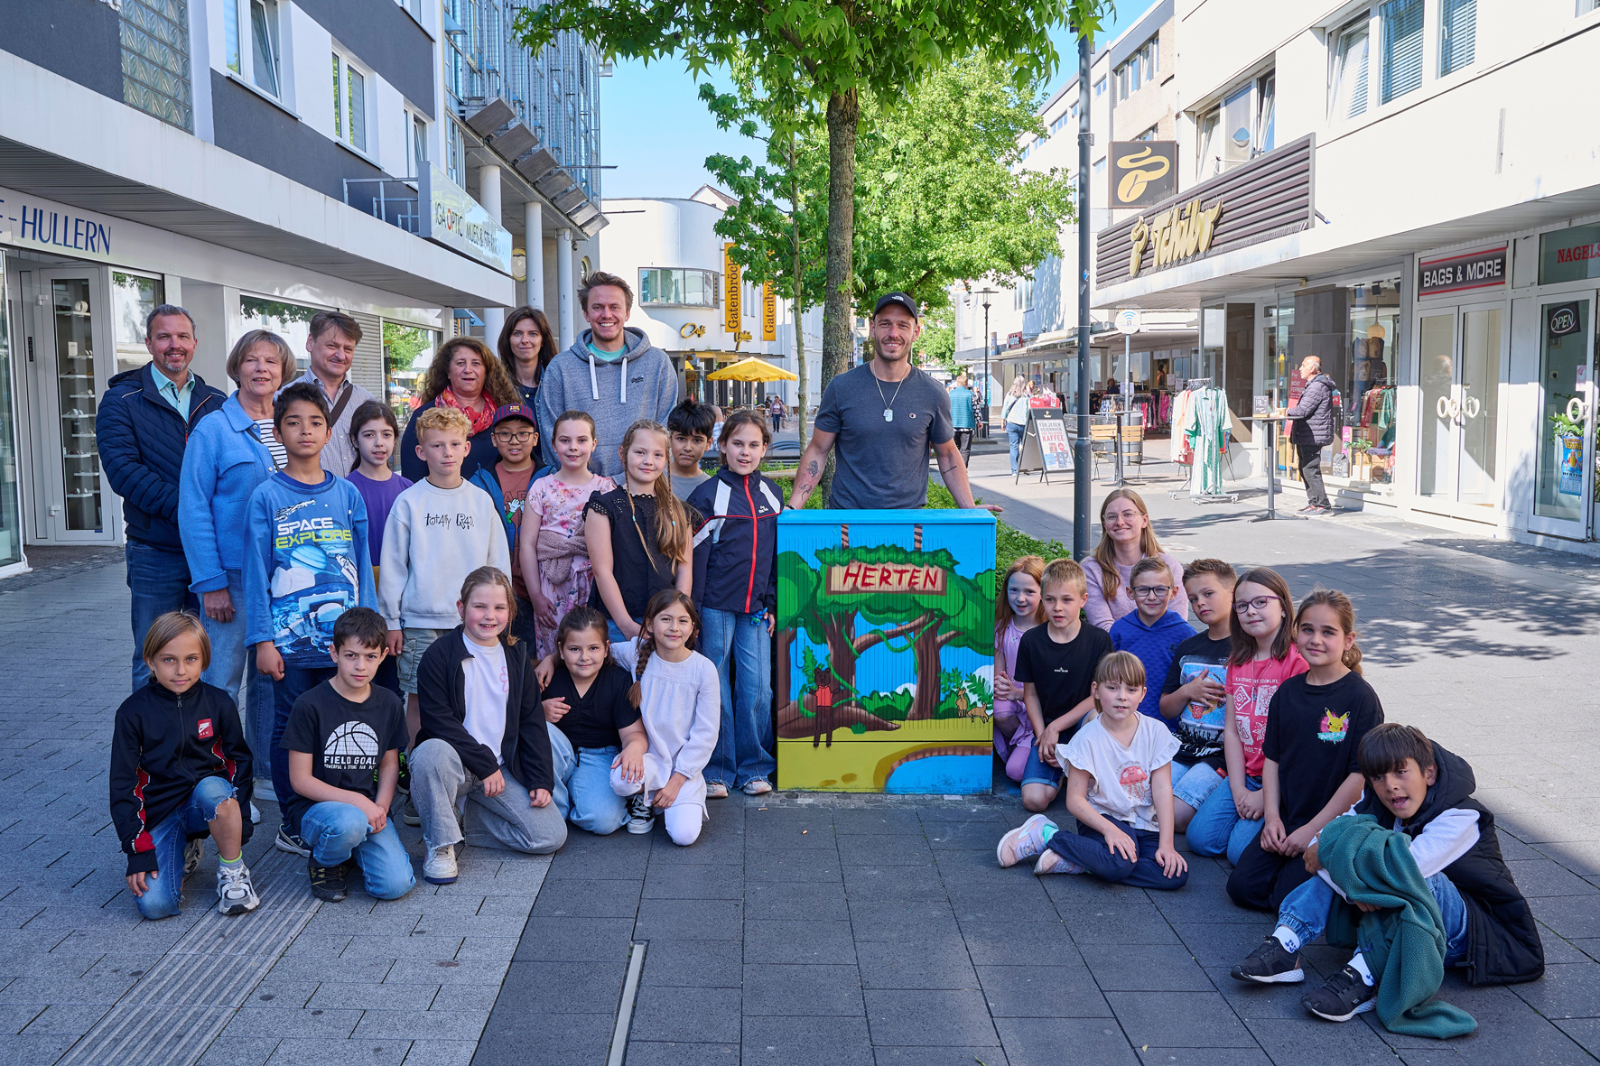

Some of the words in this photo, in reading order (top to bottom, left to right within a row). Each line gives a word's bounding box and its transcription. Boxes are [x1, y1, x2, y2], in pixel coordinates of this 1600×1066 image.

[1151, 198, 1222, 267] Tchibo
[1423, 266, 1453, 288] BAGS
[1456, 265, 1463, 283] &
[1466, 258, 1502, 281] MORE
[1551, 315, 1573, 330] OPEN
[1042, 434, 1065, 442] KAFFEE
[277, 517, 334, 536] SPACE
[275, 529, 353, 549] EXPLORE
[843, 563, 938, 589] HERTEN
[324, 755, 352, 765] FIELD
[353, 756, 377, 765] GOAL
